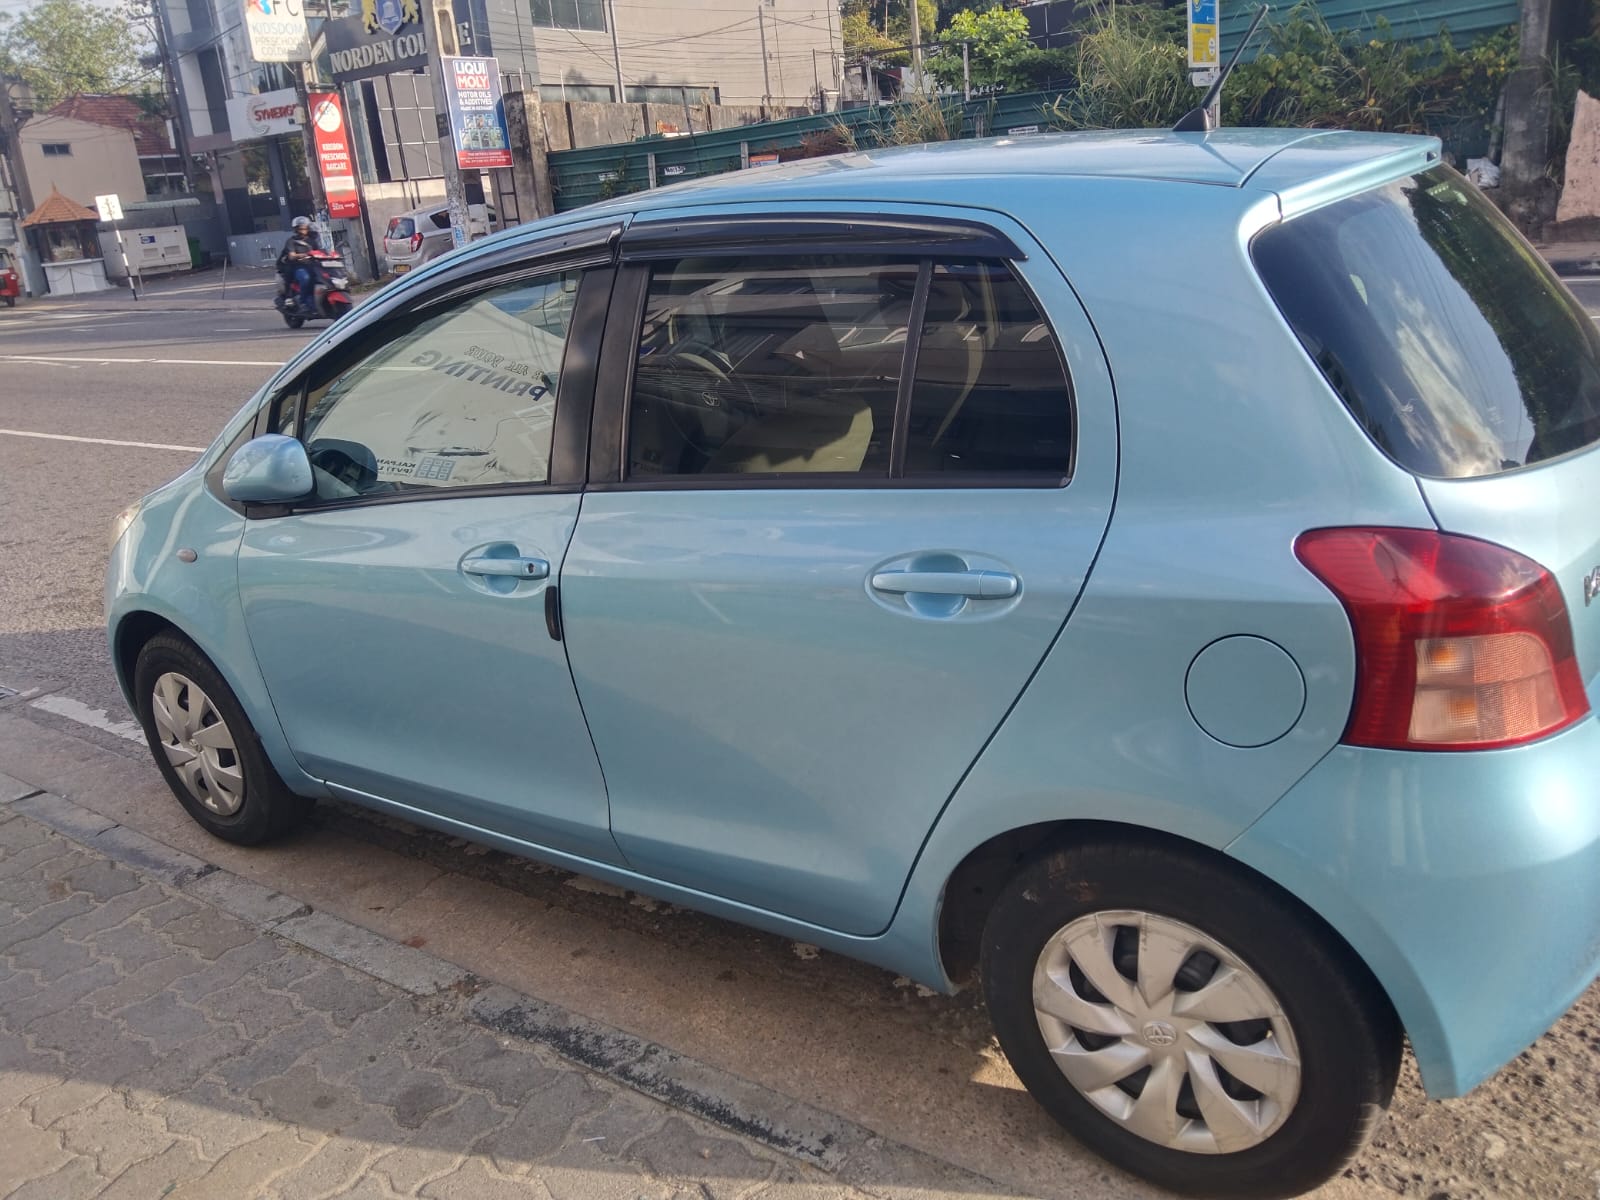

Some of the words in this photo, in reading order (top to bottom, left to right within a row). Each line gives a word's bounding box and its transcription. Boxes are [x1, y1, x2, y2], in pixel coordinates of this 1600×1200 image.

[252, 22, 303, 35] KIDSDOM
[329, 39, 396, 74] NORDEN
[396, 21, 471, 60] COLE
[455, 62, 486, 75] LIQUI
[457, 75, 488, 88] MOLY
